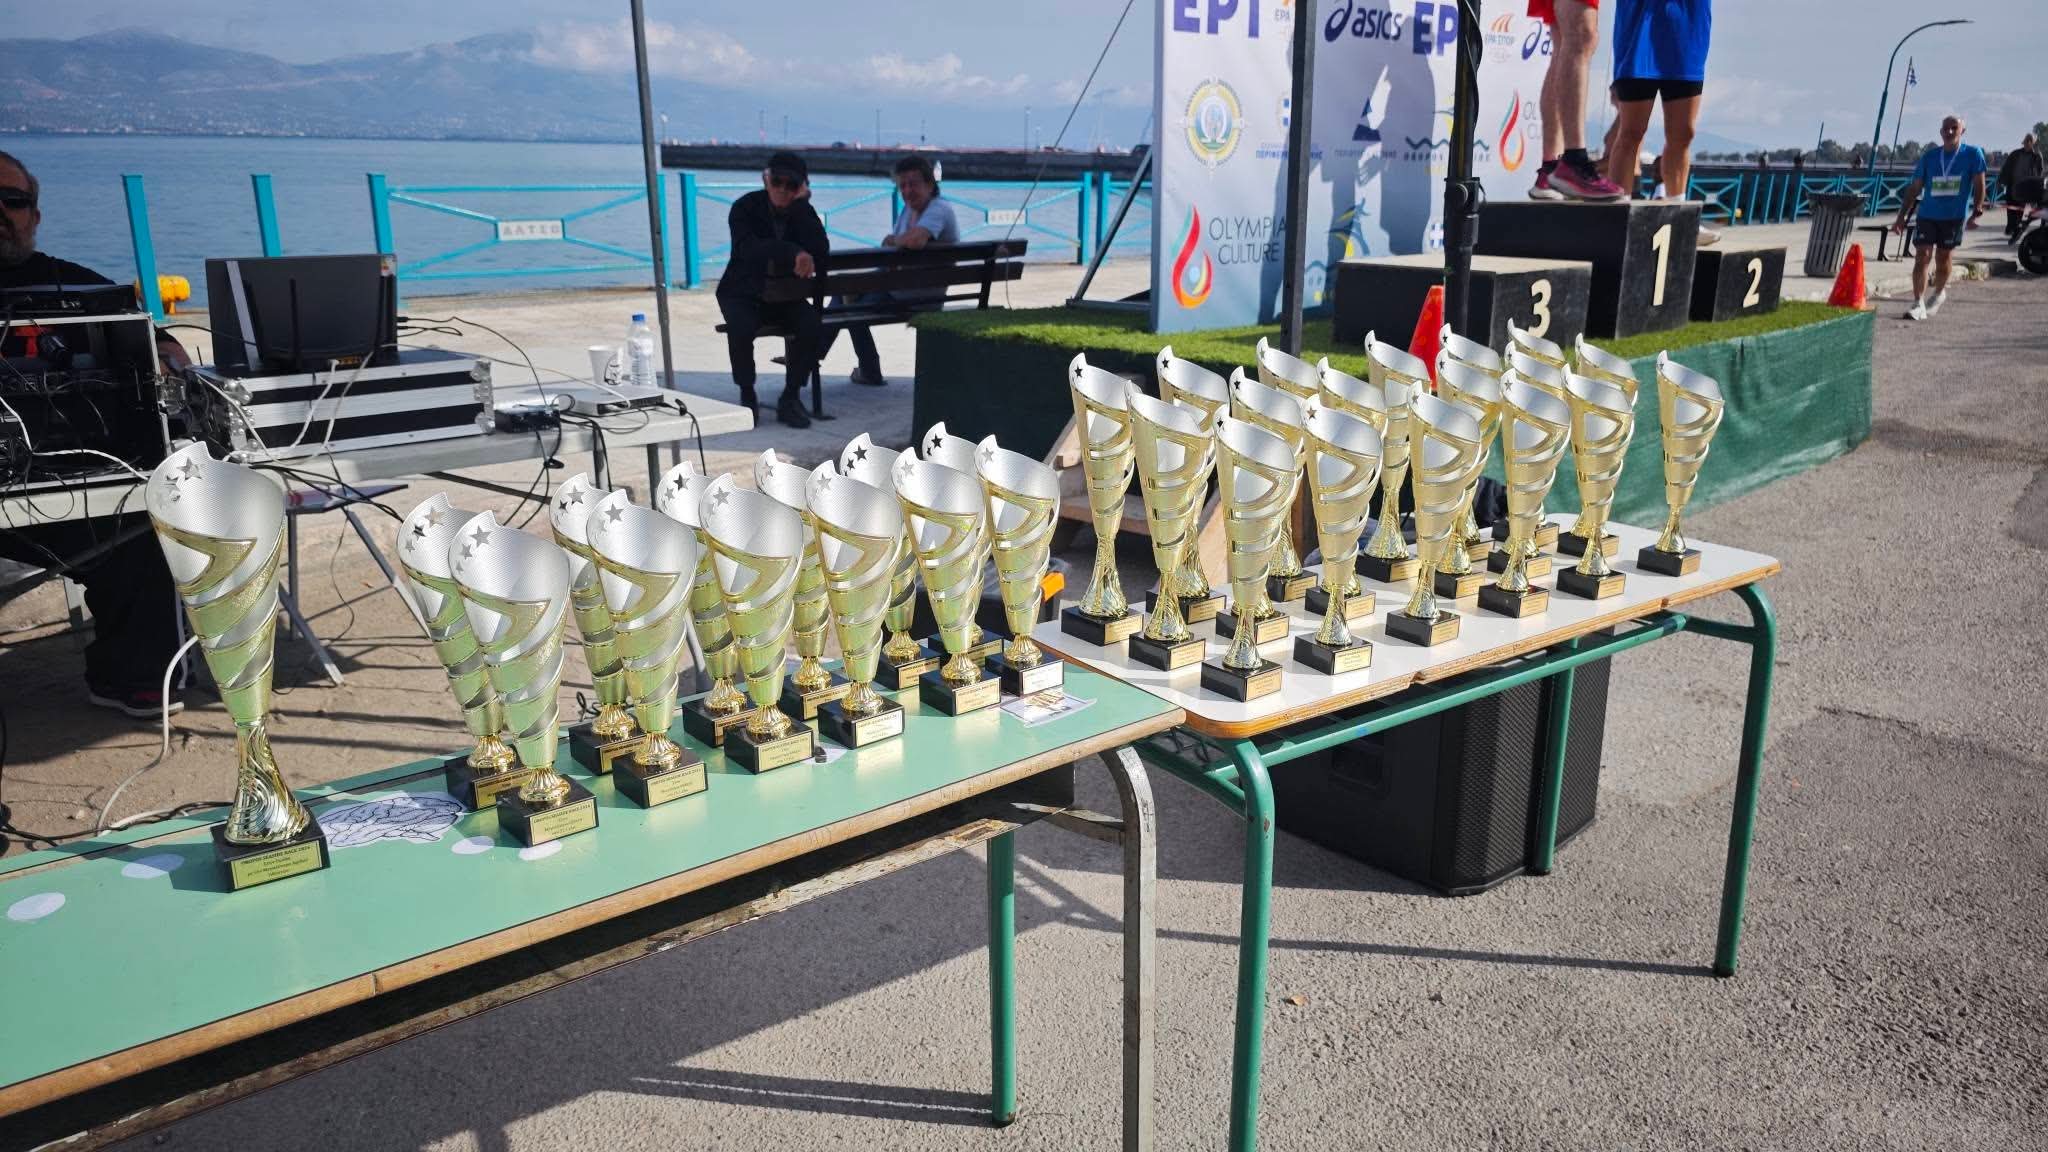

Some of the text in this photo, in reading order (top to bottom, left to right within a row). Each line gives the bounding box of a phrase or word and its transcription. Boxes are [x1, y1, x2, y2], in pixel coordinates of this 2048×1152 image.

[1351, 7, 1402, 41] asics
[1208, 215, 1287, 241] OLYMPIA
[1217, 242, 1280, 265] CULTURE
[1651, 223, 1672, 306] 1
[1742, 256, 1763, 309] 2
[1529, 277, 1552, 338] 3
